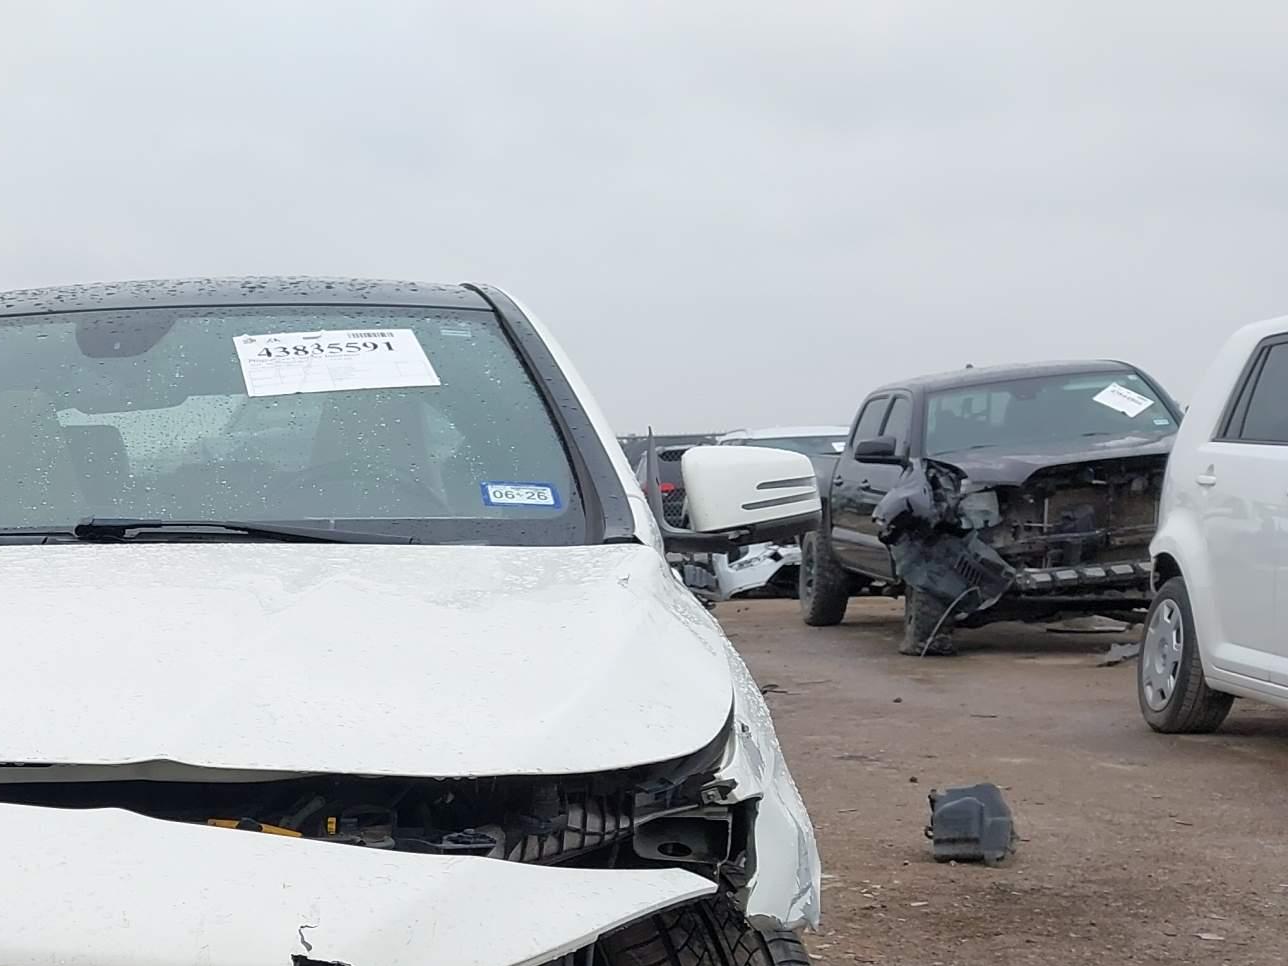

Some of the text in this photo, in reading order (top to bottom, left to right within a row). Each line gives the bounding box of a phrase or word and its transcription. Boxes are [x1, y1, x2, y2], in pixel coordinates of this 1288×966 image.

[257, 340, 396, 358] 43835591
[492, 489, 549, 501] 06 26
